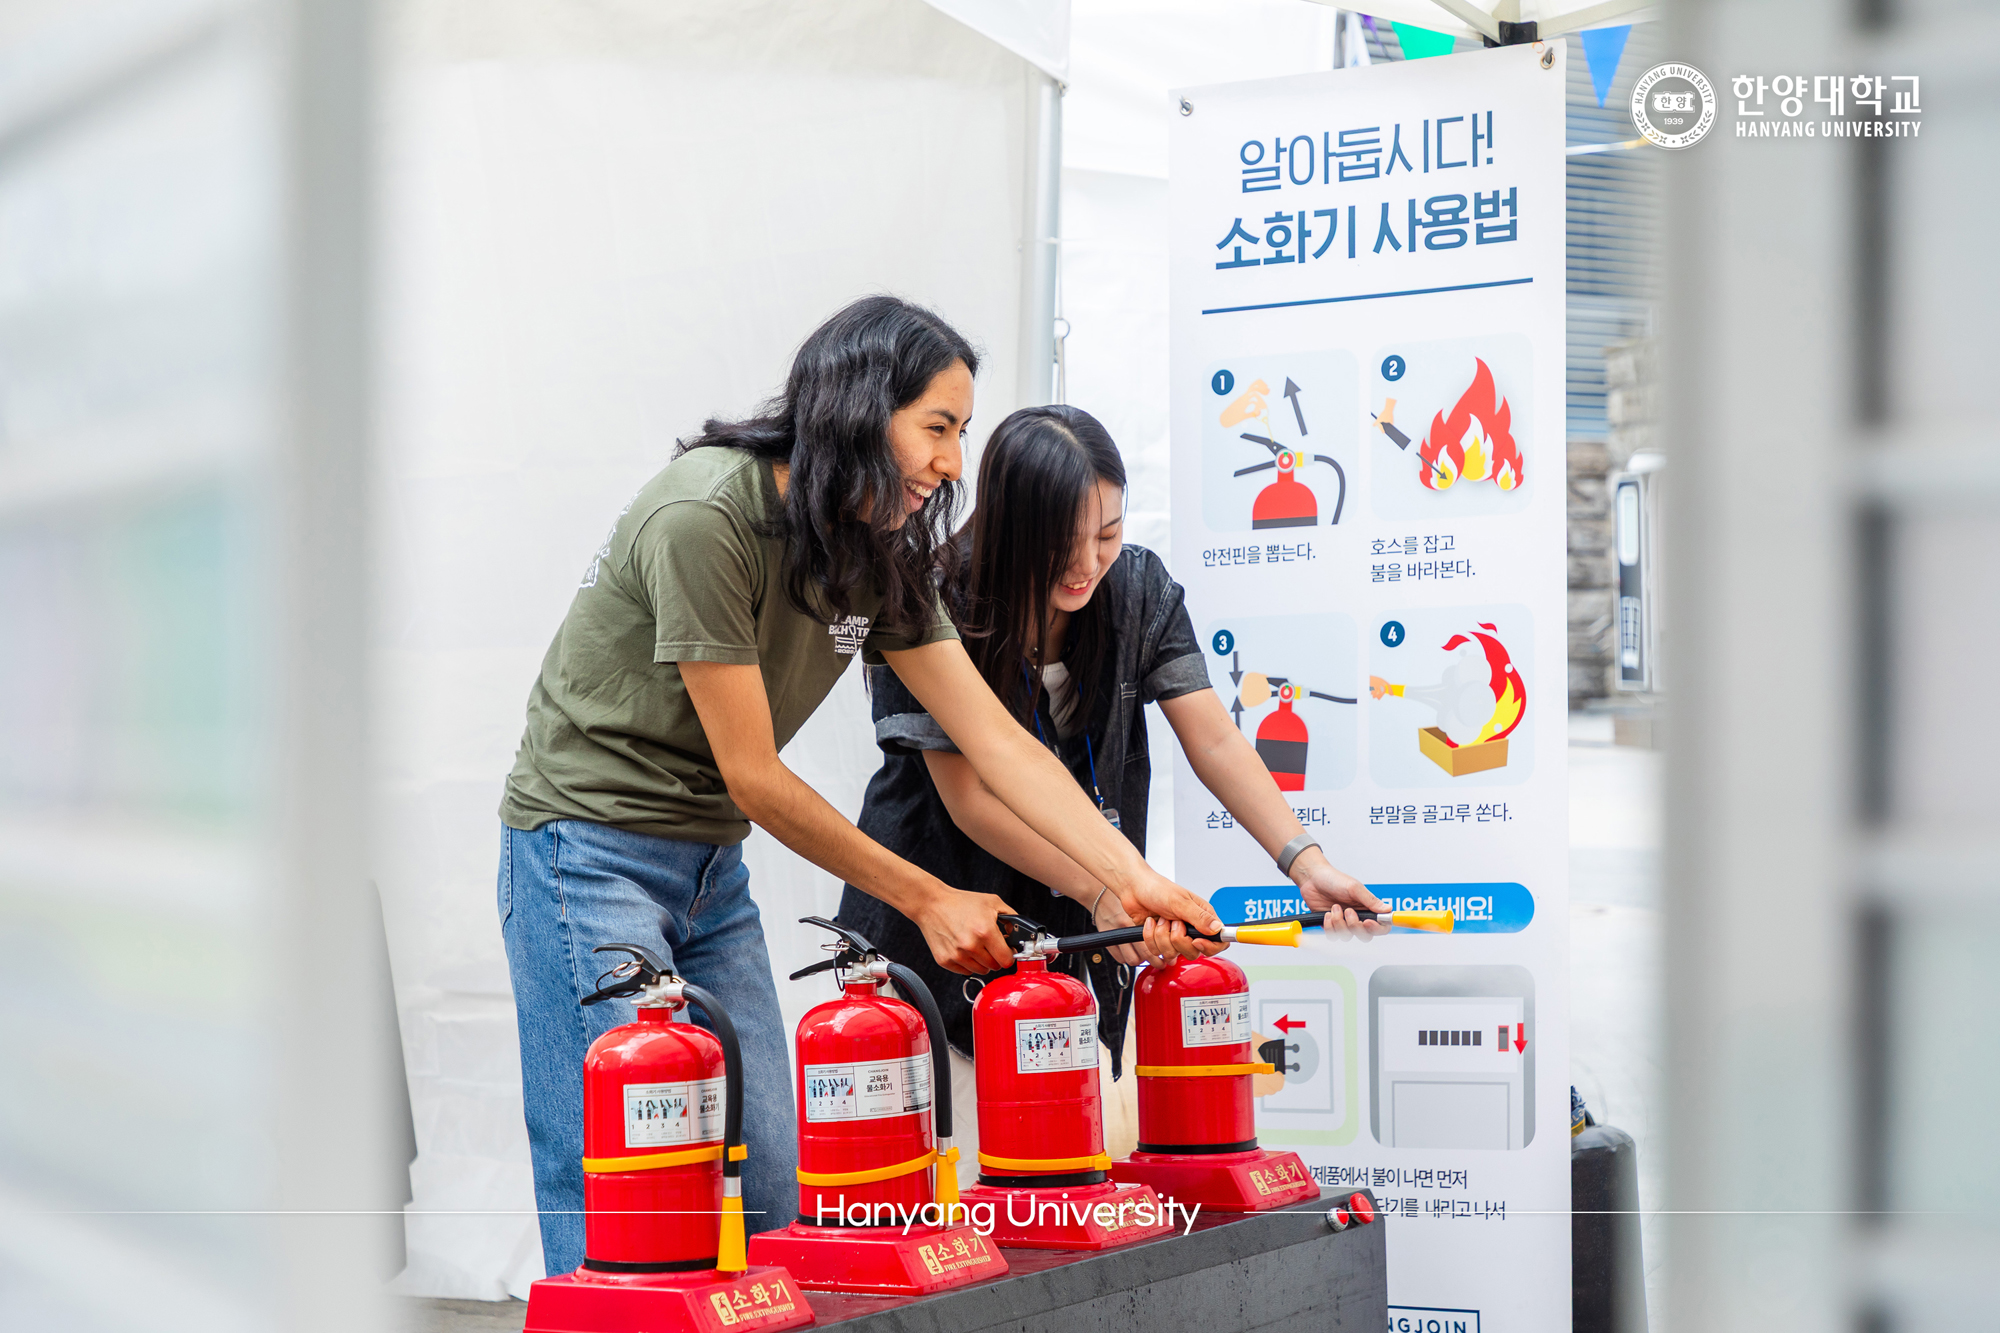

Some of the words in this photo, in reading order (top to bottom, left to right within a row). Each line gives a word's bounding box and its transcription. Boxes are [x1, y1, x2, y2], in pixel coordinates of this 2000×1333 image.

[1239, 110, 1494, 194] 알아둡시다!
[1215, 205, 1356, 270] 소화기
[1372, 187, 1518, 255] 사용법
[1389, 360, 1398, 376] 2
[1202, 546, 1262, 567] 안전핀을
[1266, 542, 1316, 563] 뽑는다.
[1370, 536, 1419, 555] 호스를
[1423, 534, 1456, 554] 잡고
[1370, 563, 1403, 583] 불을
[1407, 558, 1476, 581] 바라본다.
[841, 615, 869, 627] AMP
[1219, 635, 1227, 651] 3
[1388, 626, 1397, 642] 4
[1369, 804, 1418, 825] 분말을
[1422, 803, 1472, 823] 골고루
[1475, 802, 1513, 822] 쏜다.
[866, 1082, 893, 1093] 물소화기
[869, 1074, 889, 1083] 교육용
[1264, 1161, 1304, 1185] 소화기
[1308, 1164, 1370, 1187] 제품에서
[1371, 1167, 1401, 1188] 불이
[1403, 1168, 1434, 1189] 나면
[1436, 1169, 1468, 1190] 먼저
[1376, 1196, 1420, 1218] 단기를
[1425, 1198, 1472, 1219] 내리고
[1474, 1199, 1506, 1221] 나서
[937, 1233, 988, 1262] 소화기
[943, 1262, 957, 1272] FIRE
[732, 1278, 792, 1310] 소화기
[739, 1311, 755, 1322] FIRE
